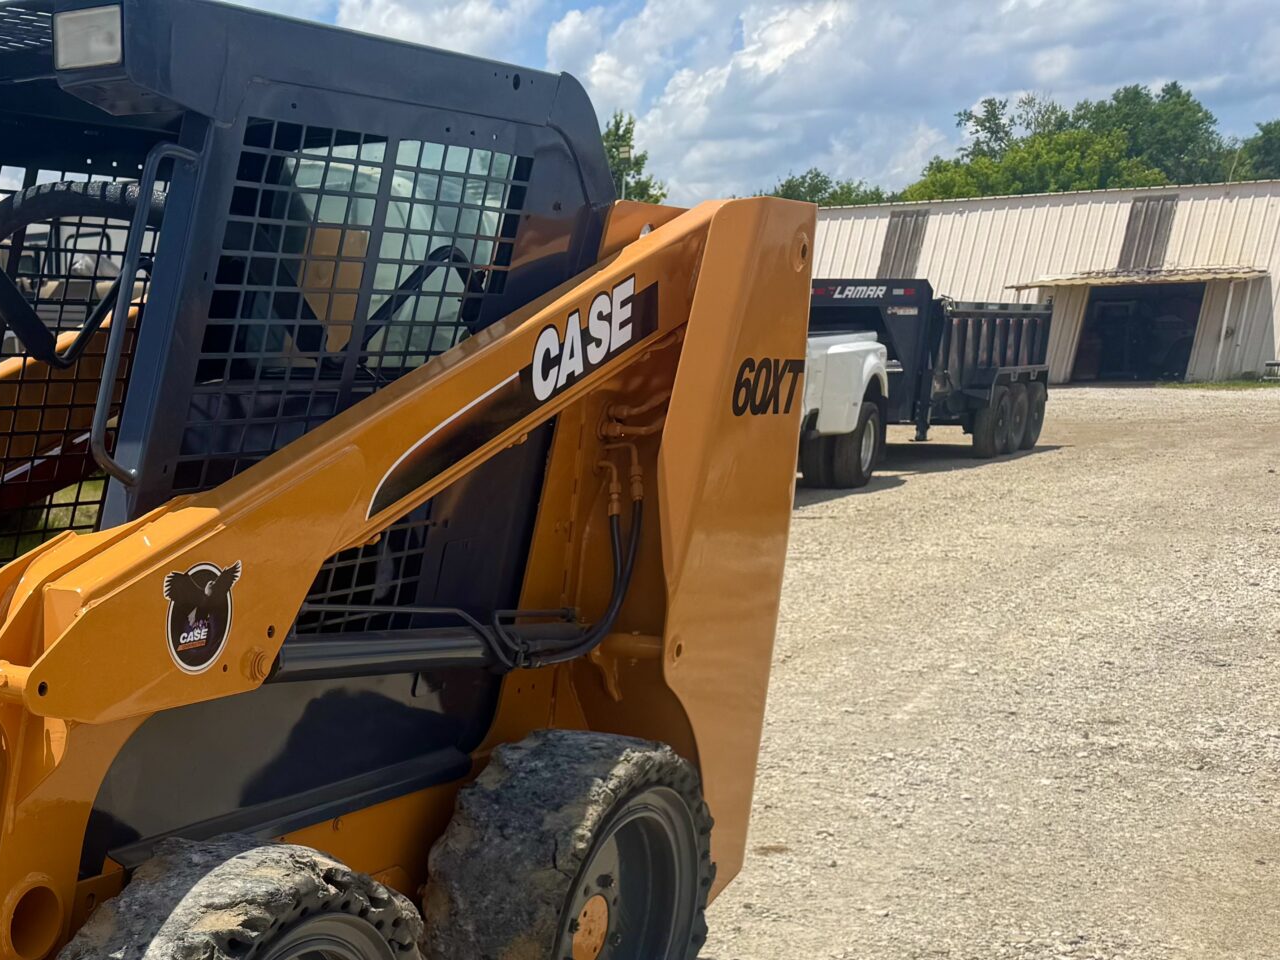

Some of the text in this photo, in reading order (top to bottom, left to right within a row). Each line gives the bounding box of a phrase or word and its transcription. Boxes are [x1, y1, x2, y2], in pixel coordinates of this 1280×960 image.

[833, 286, 887, 299] LAMAR
[531, 274, 636, 402] CASE
[732, 357, 805, 417] 60XT
[179, 628, 208, 644] CASE
